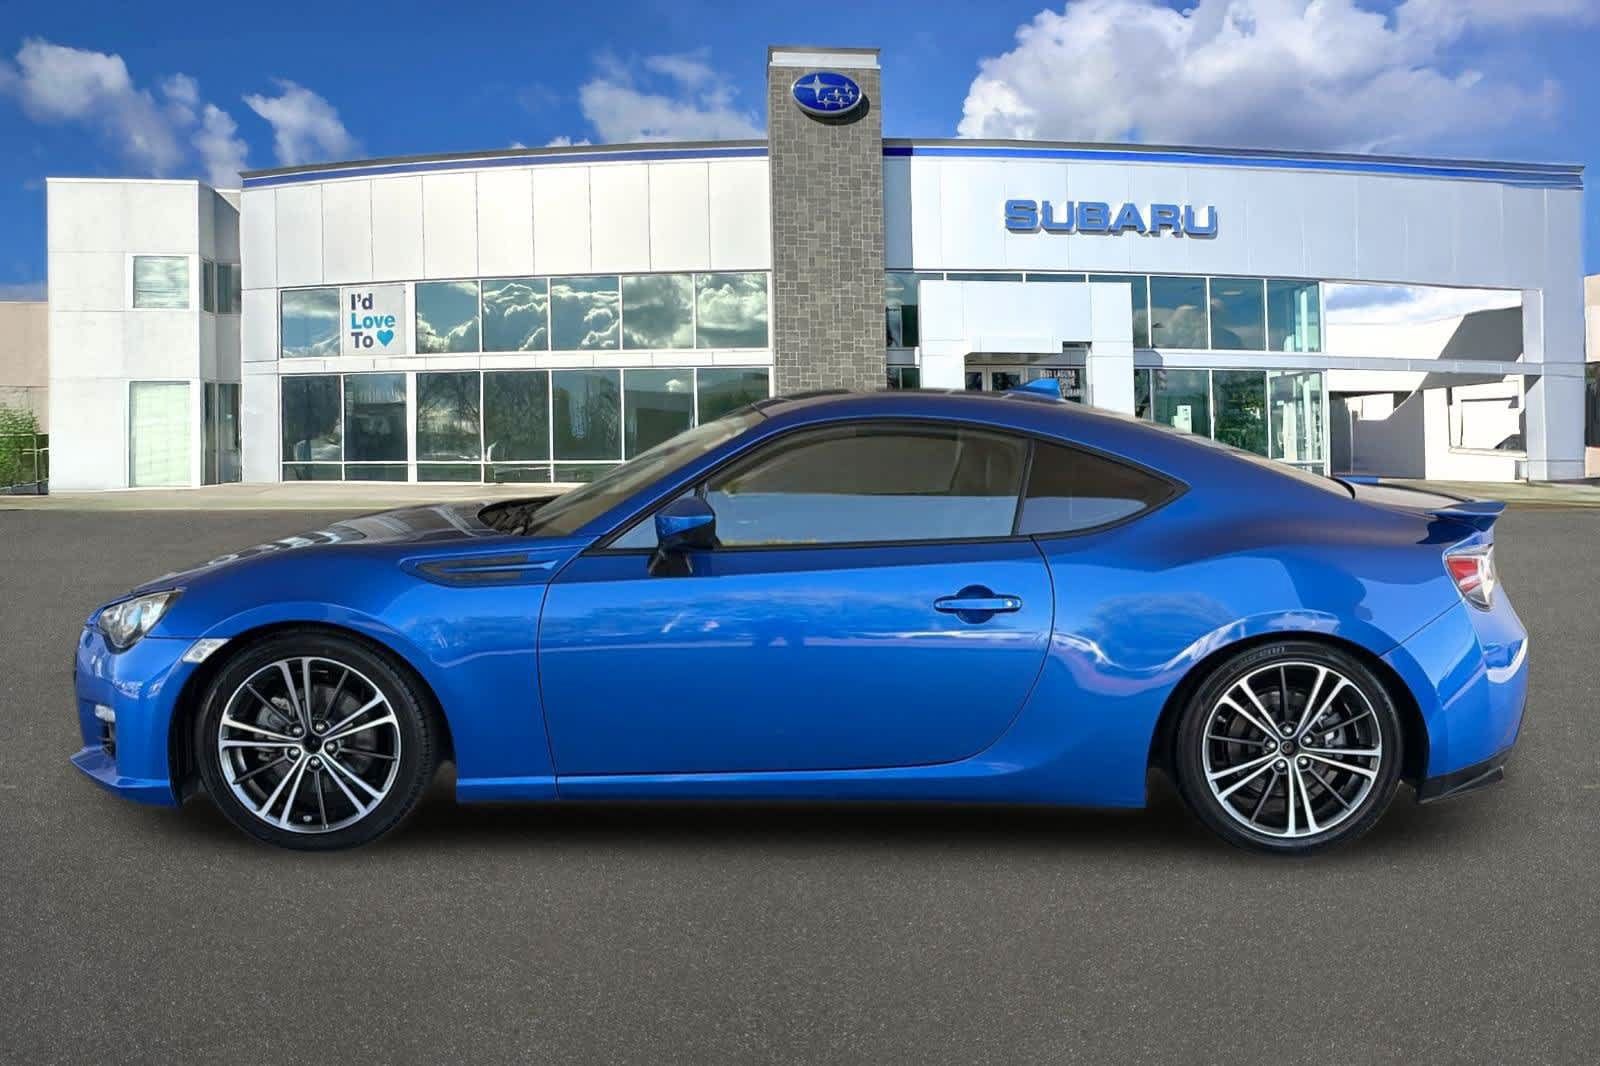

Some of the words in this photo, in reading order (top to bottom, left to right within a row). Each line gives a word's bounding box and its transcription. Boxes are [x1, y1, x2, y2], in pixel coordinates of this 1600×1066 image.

[1005, 199, 1218, 238] SUBARU
[351, 293, 373, 310] I'd
[351, 313, 396, 329] Love
[351, 332, 374, 348] To
